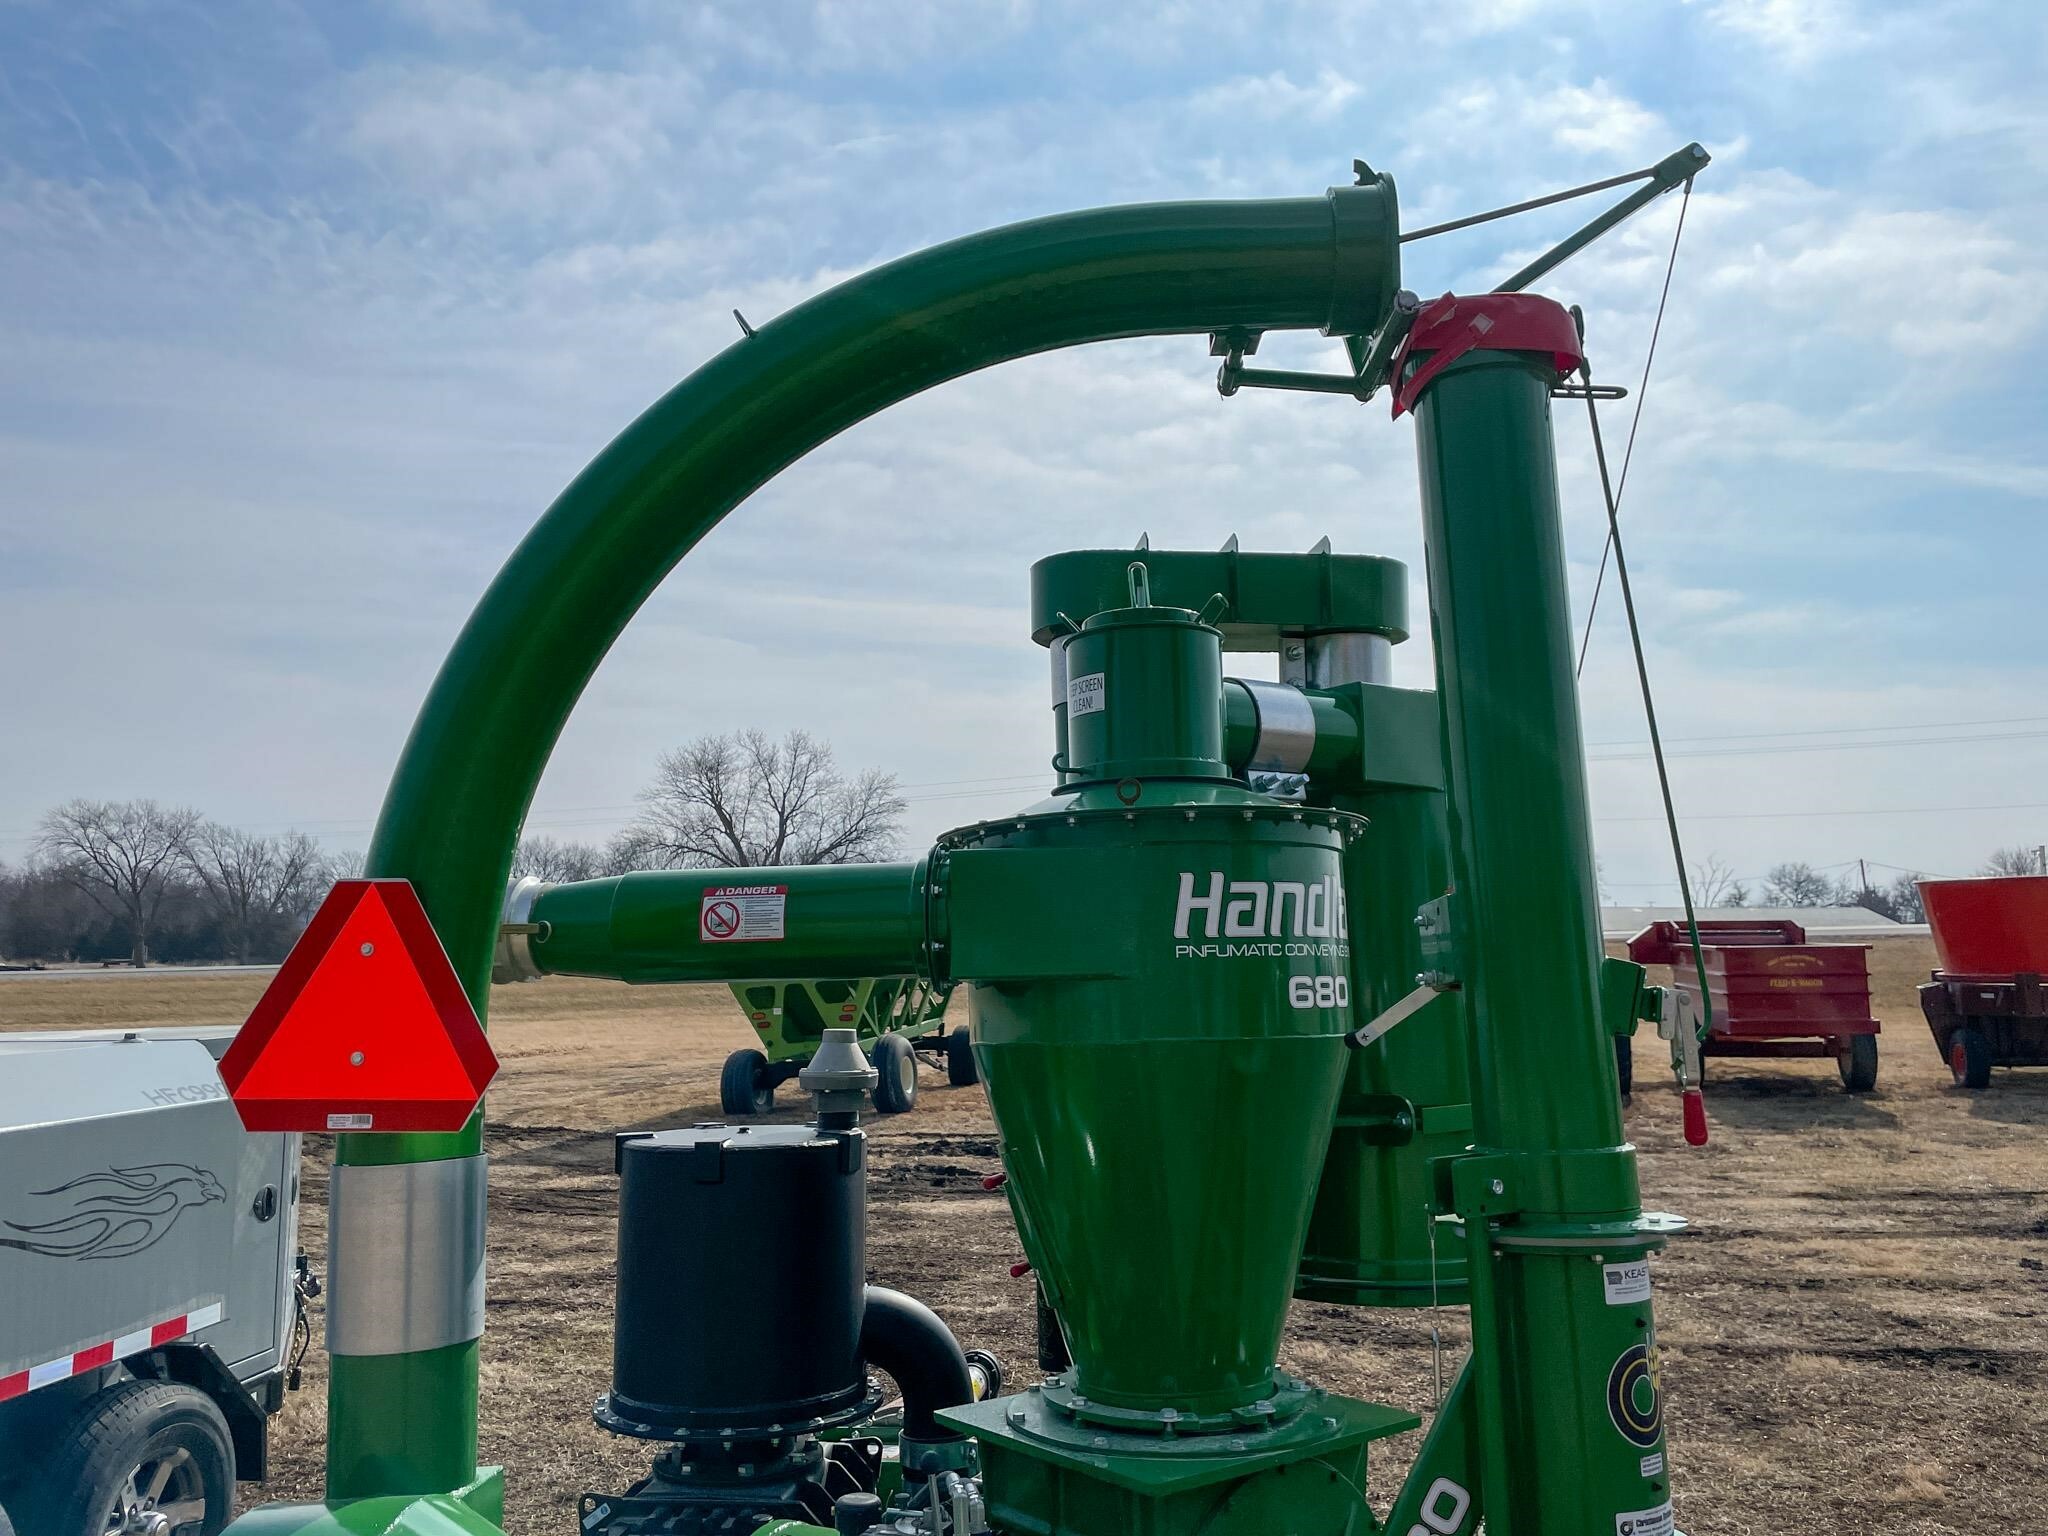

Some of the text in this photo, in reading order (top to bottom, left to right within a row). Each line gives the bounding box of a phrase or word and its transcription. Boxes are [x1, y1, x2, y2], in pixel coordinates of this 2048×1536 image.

[1078, 677, 1102, 695] SCREEN
[1073, 696, 1094, 713] CLEAN!
[725, 886, 777, 896] DANGER
[1288, 975, 1349, 1009] 680
